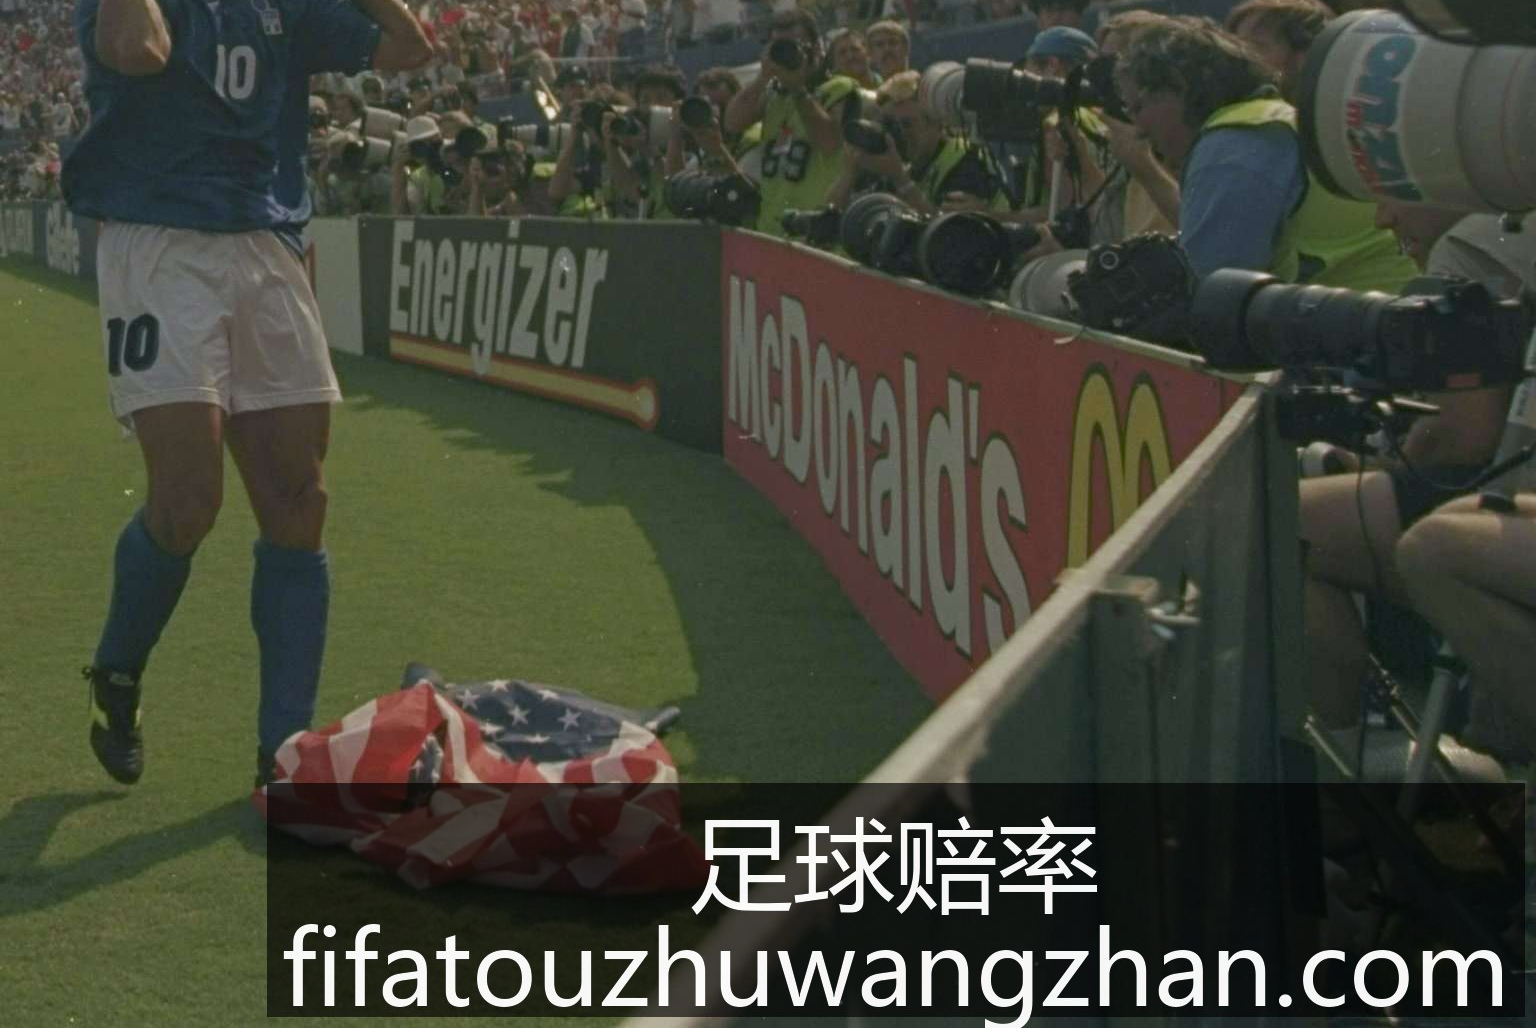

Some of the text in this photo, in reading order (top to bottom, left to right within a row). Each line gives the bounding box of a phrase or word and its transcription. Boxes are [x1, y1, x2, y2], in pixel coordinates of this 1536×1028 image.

[214, 44, 256, 99] 10
[107, 313, 161, 377] 10
[390, 219, 608, 376] Energizer
[728, 275, 1032, 660] McDonald's
